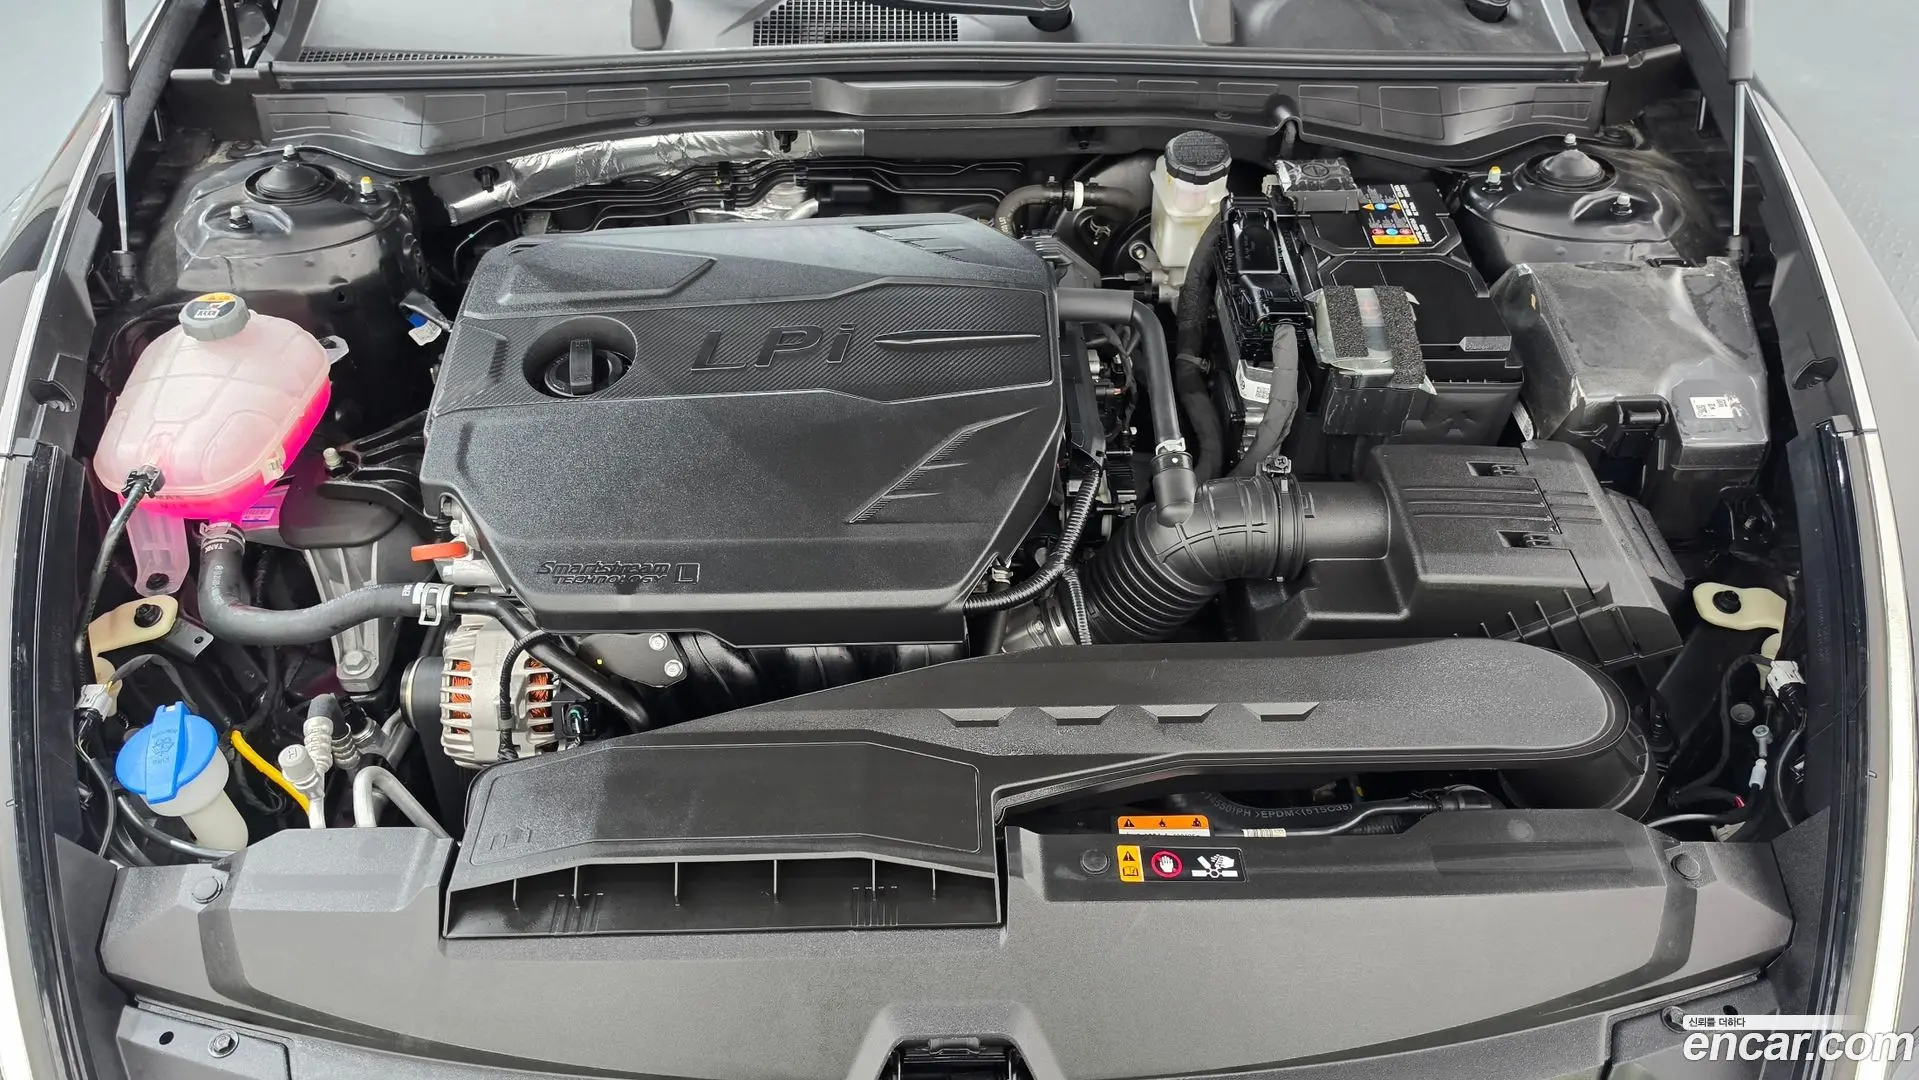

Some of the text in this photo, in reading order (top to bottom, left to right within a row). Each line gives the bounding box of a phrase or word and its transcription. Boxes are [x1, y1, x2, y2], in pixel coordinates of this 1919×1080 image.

[691, 323, 856, 371] LPi
[536, 560, 671, 574] Smartstream
[553, 574, 668, 584] TECHNOLOGY
